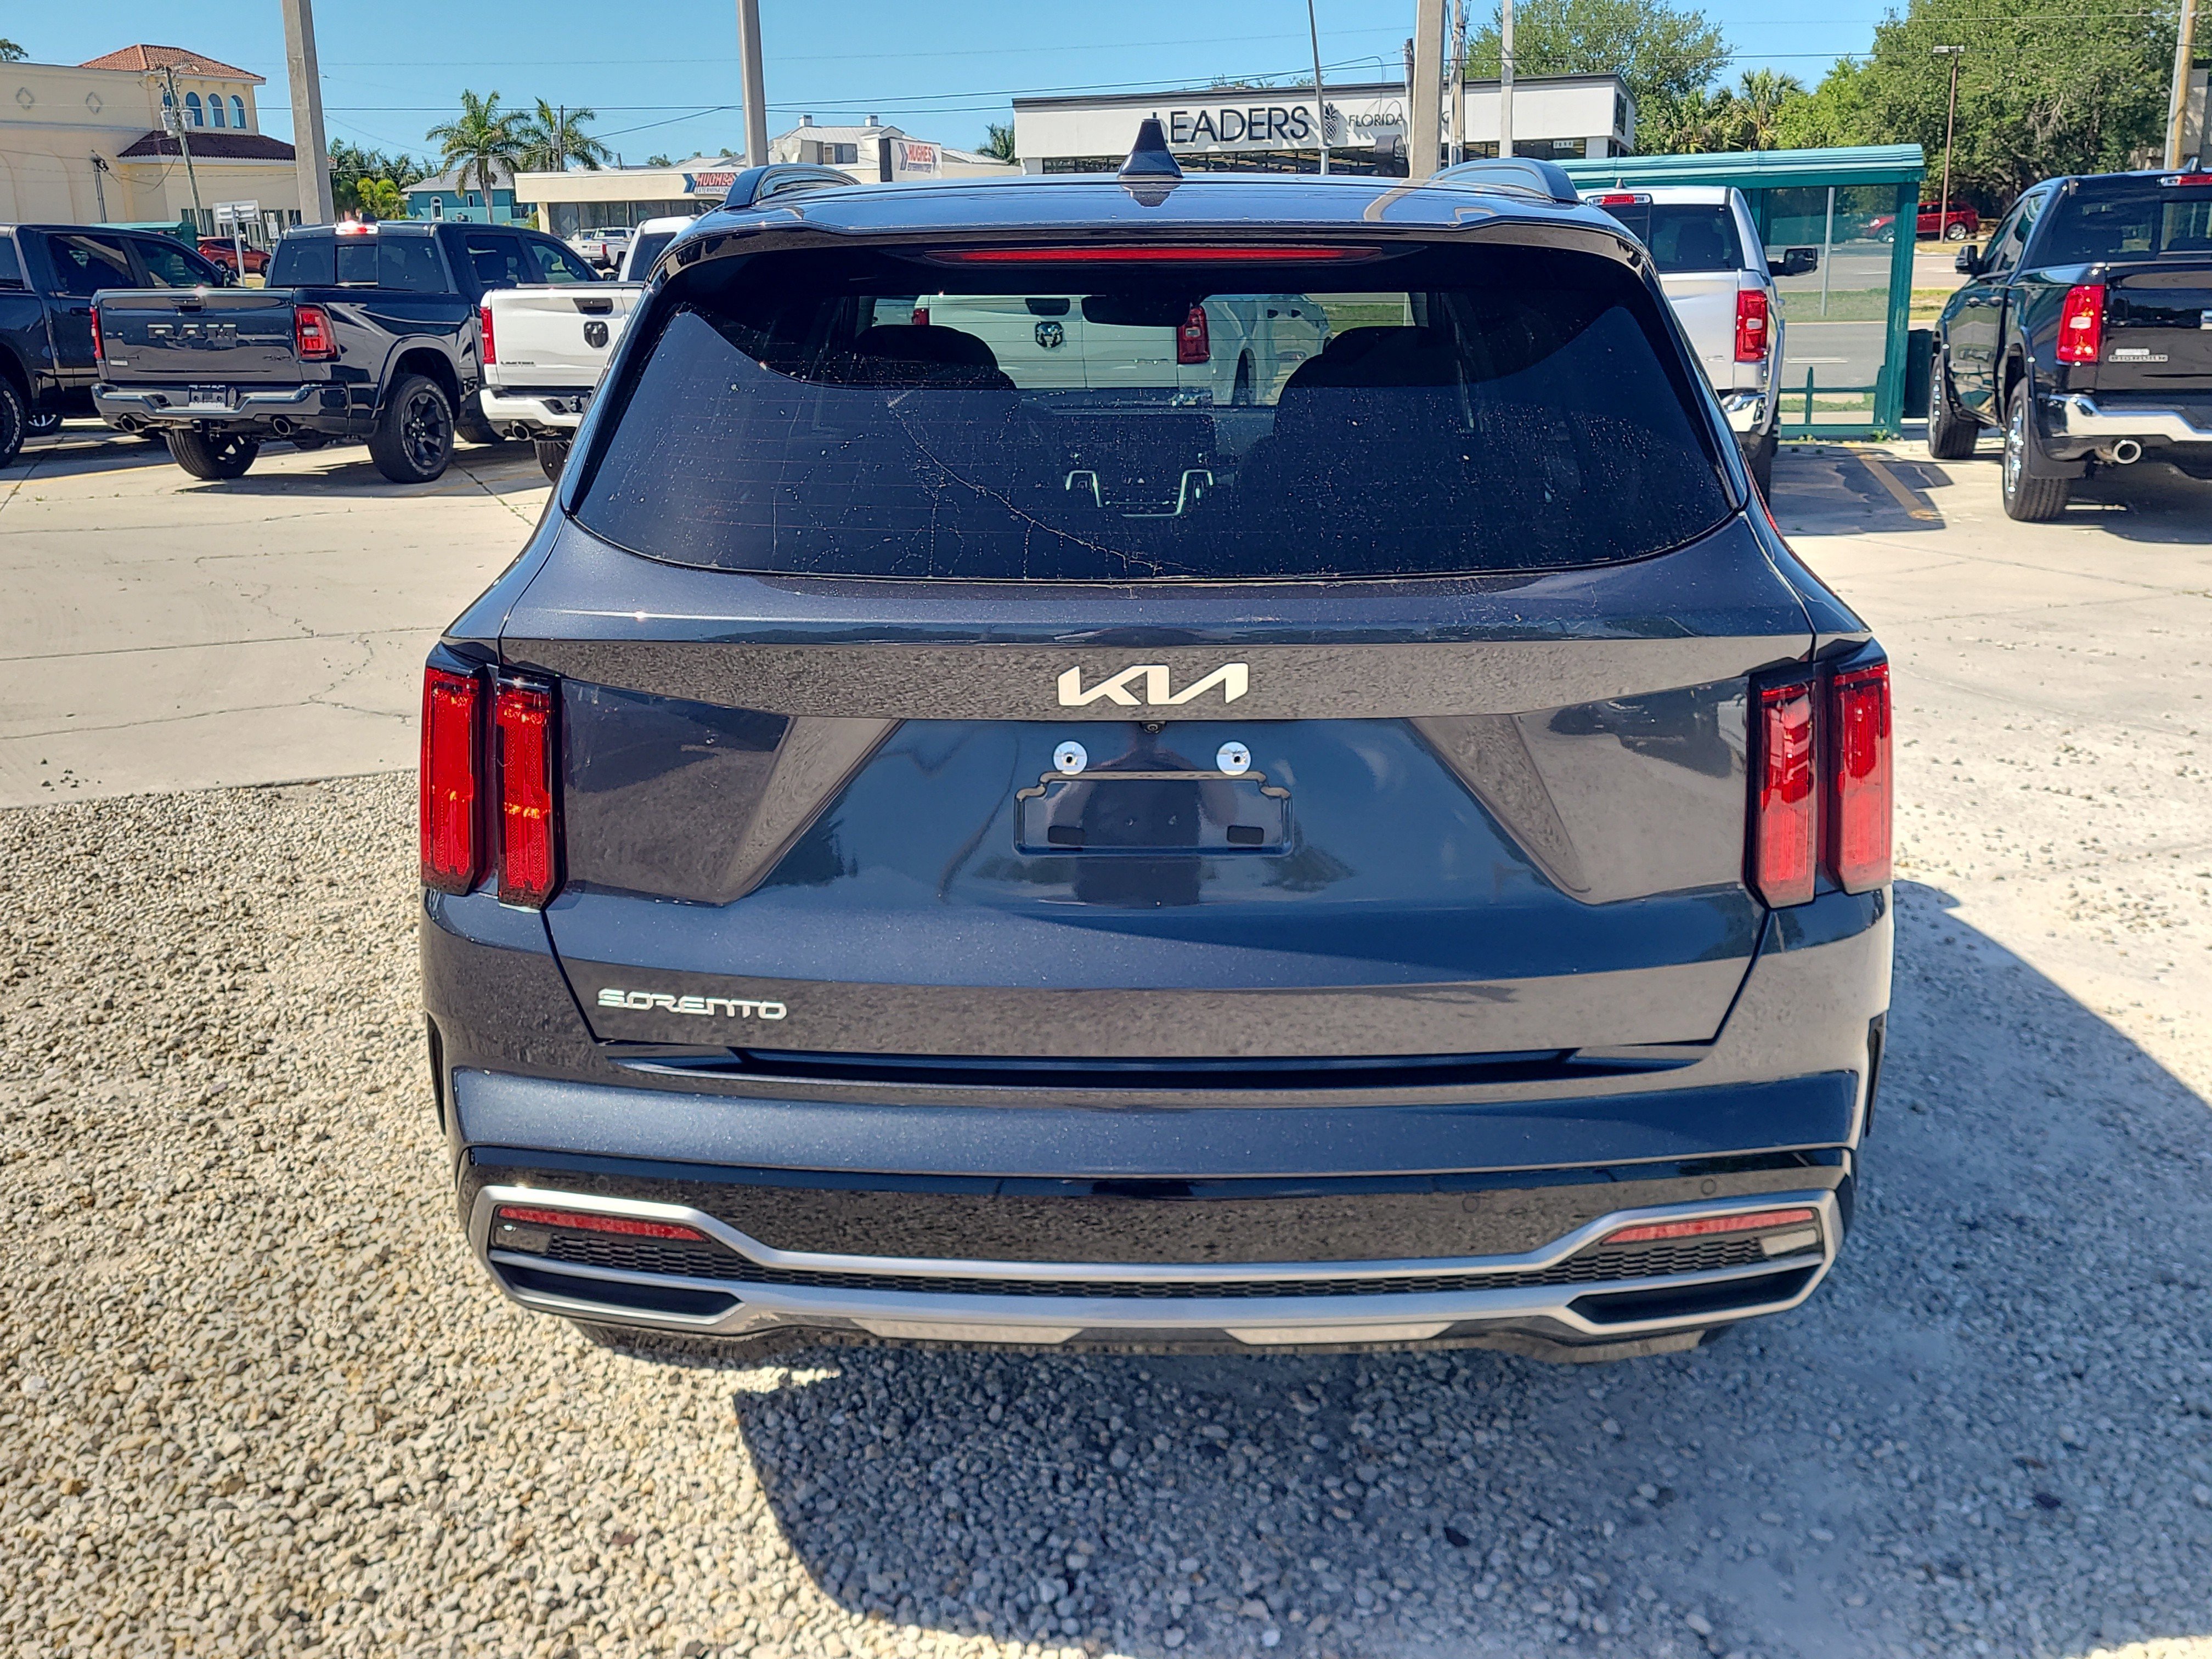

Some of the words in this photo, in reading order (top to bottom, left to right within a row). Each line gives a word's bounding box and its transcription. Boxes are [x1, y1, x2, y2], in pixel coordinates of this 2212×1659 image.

[1153, 105, 1309, 143] EADERS
[1349, 114, 1403, 127] FLORIDA
[909, 144, 932, 162] HUGHES
[696, 173, 735, 187] HUGHES
[147, 324, 236, 339] RAM
[1058, 662, 1249, 706] KIA
[597, 988, 787, 1020] SORENTO
